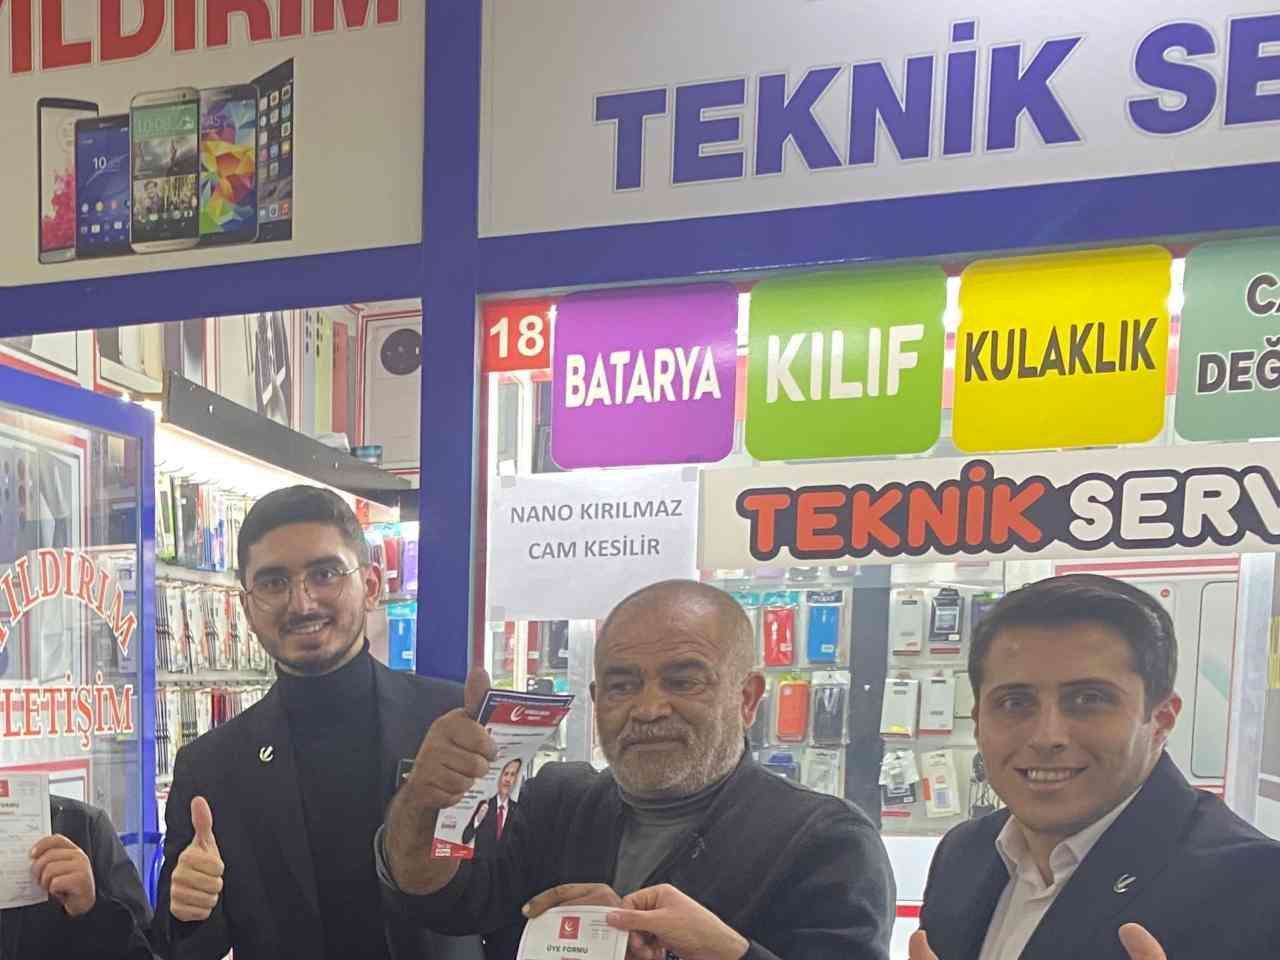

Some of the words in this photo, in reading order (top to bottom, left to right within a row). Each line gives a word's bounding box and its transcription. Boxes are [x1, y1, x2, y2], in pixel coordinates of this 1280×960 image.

[593, 20, 1083, 191] TEKNİK
[1245, 272, 1280, 317] C
[489, 315, 545, 360] 18
[764, 323, 925, 405] KILIF
[963, 316, 1160, 384] KULAKLIK
[564, 344, 722, 409] BATARYA
[510, 504, 573, 524] NANO
[579, 499, 683, 521] KIRILMAZ
[738, 462, 1050, 557] TEKNİK
[528, 541, 577, 560] CAM
[584, 534, 661, 558] KESİLİR
